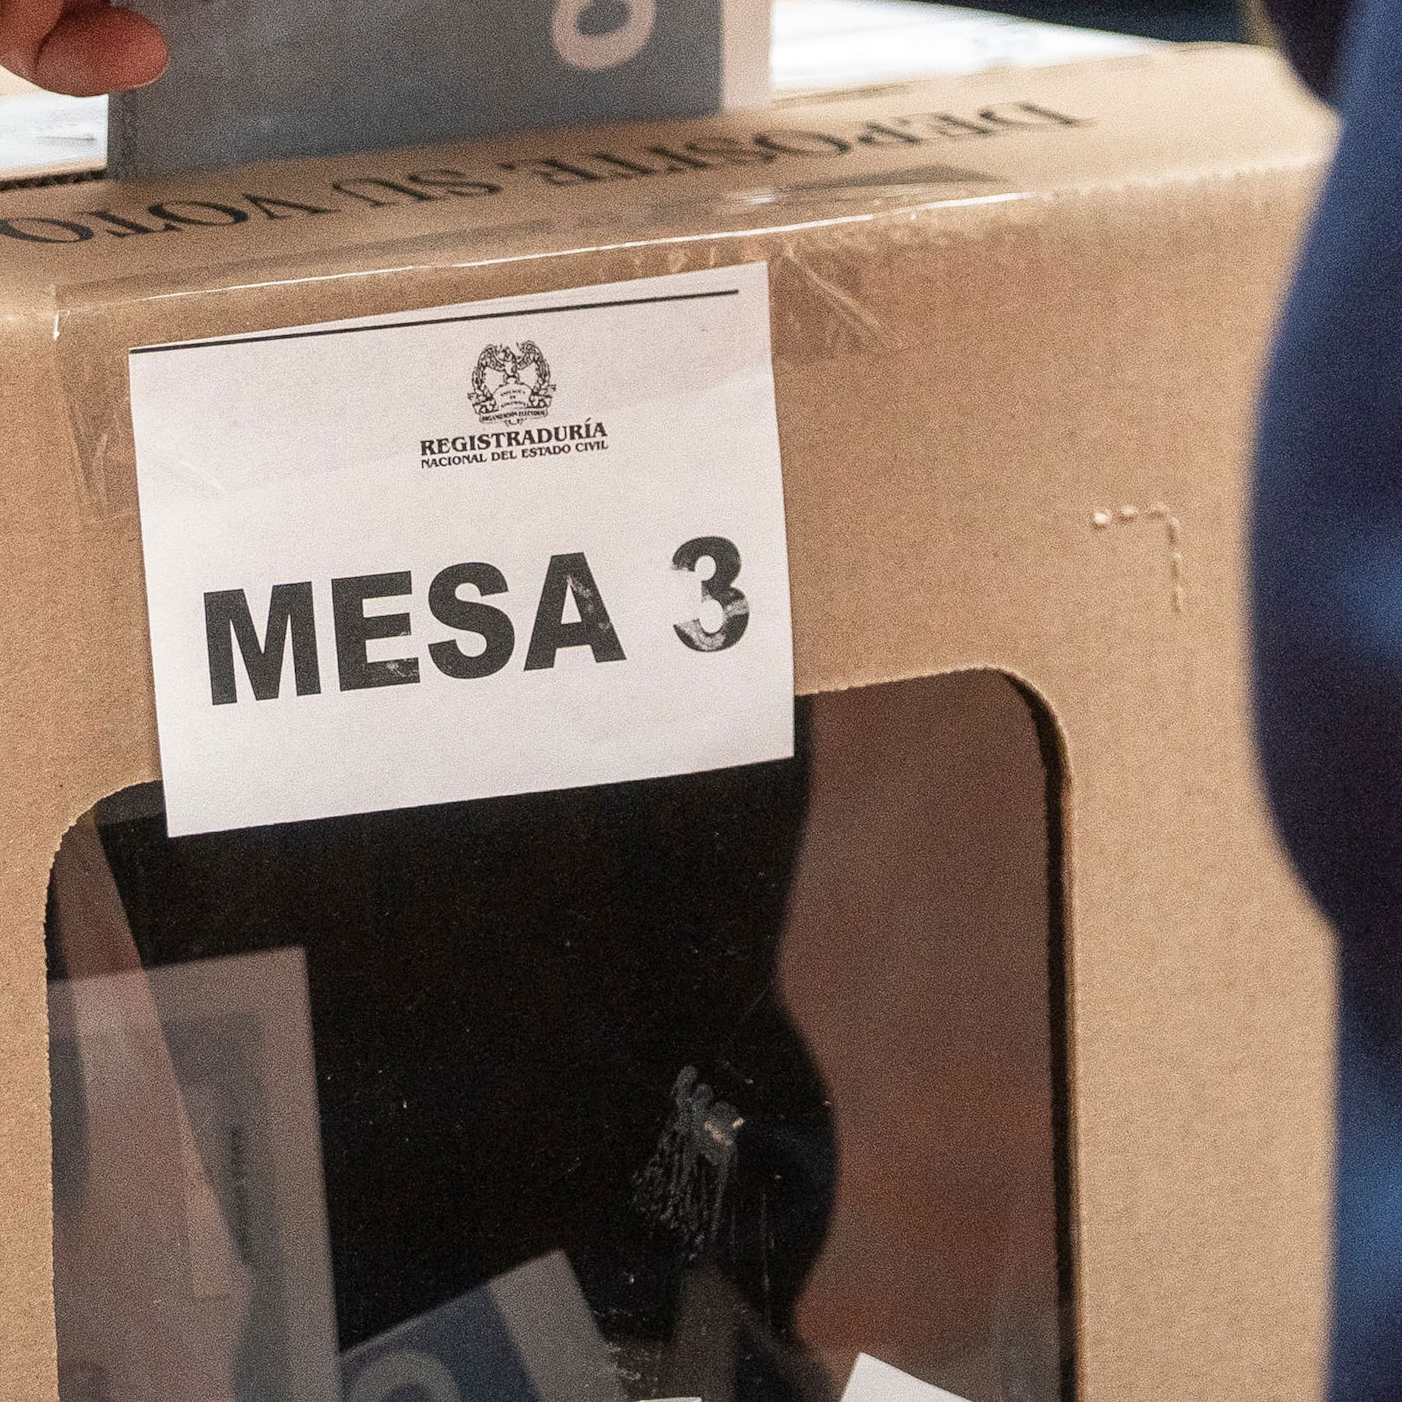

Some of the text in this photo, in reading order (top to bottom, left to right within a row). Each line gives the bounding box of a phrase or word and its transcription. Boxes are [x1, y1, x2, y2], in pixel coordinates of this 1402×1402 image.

[501, 101, 1094, 188] DEPOSITE
[331, 168, 502, 210] SU
[419, 416, 609, 457] REGISTRADURÍA
[420, 439, 610, 470] NACIONAL DEL ESTADO CIVIL
[202, 535, 751, 707] MESA 3
